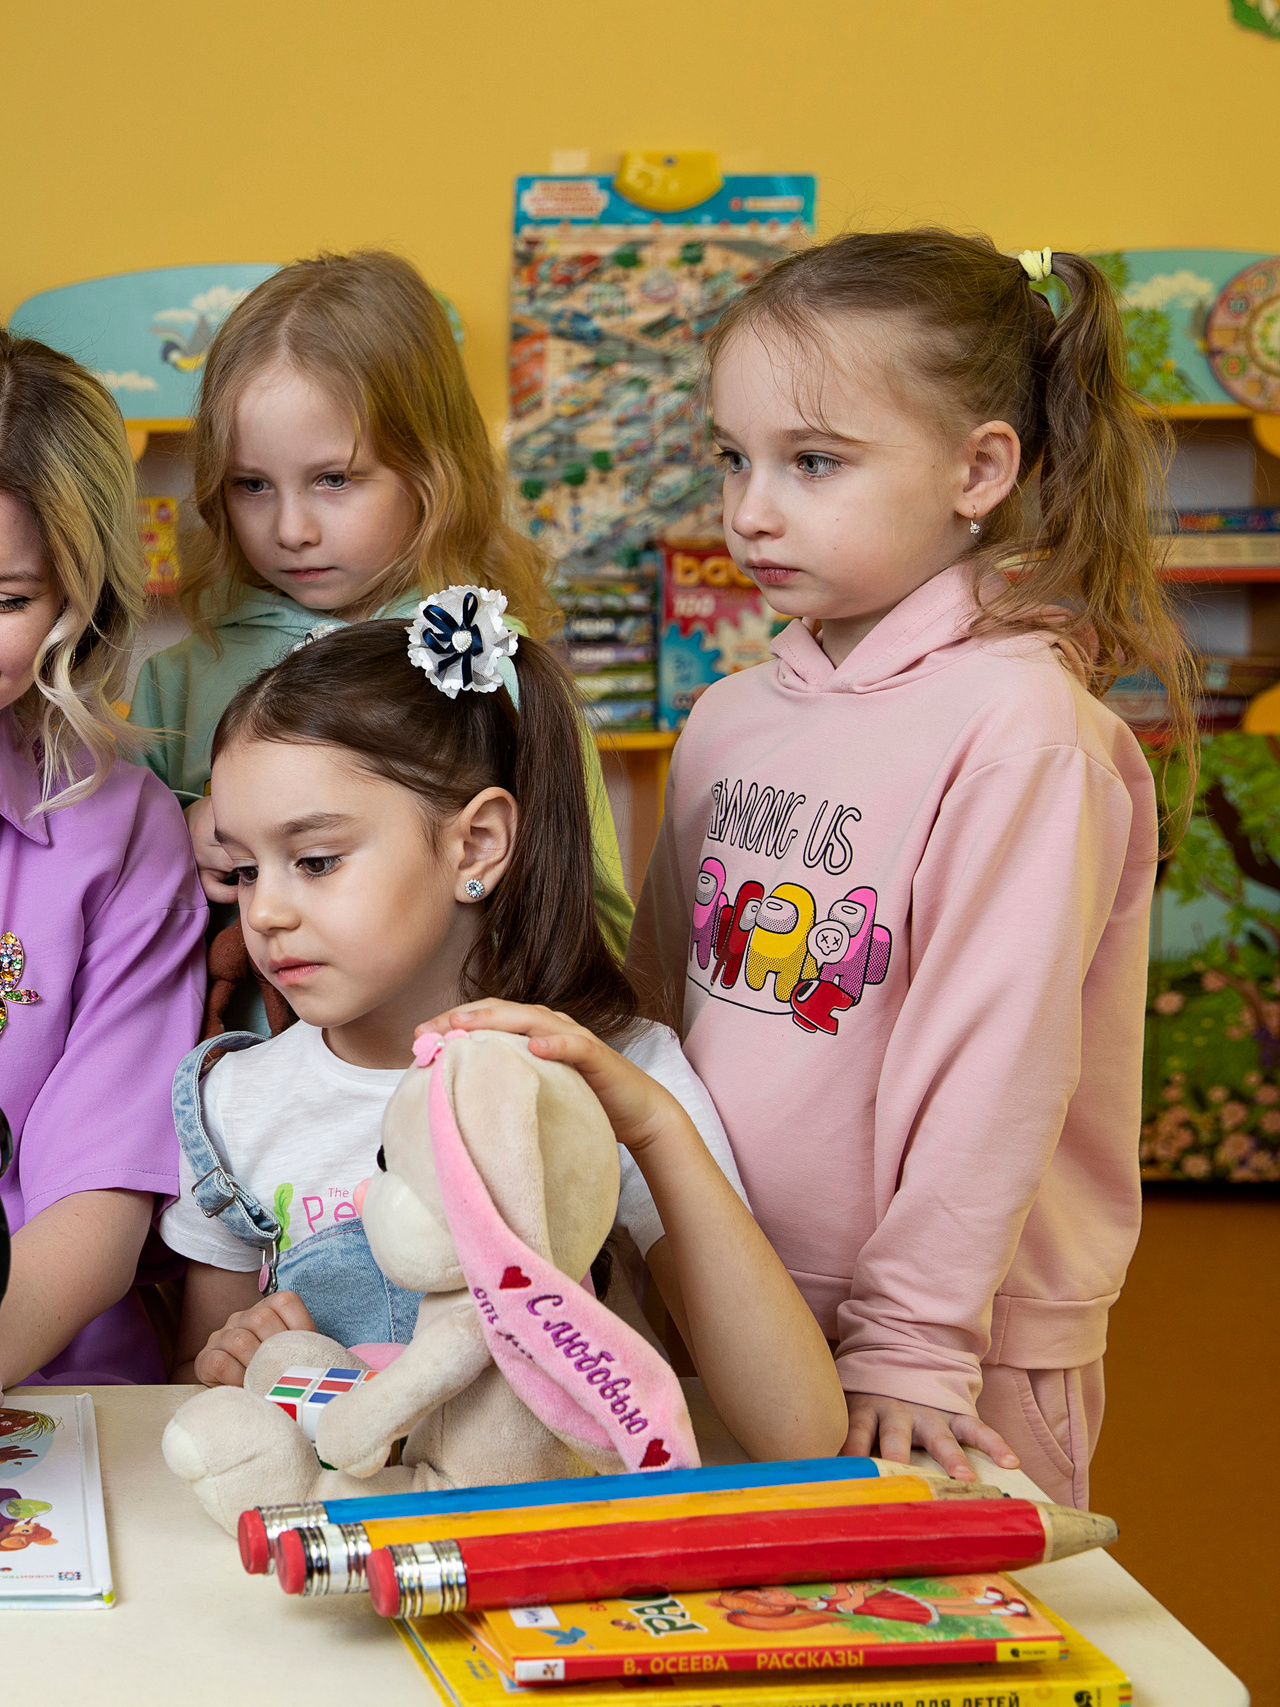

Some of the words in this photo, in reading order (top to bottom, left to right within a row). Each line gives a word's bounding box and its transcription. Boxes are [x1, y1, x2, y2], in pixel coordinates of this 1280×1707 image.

[803, 800, 862, 875] US
[328, 1187, 350, 1198] The
[543, 1320, 649, 1436] любовью
[623, 1659, 643, 1676] В.
[649, 1655, 730, 1674] ОСЕЕВА
[756, 1650, 865, 1670] РАССКАЗЫ
